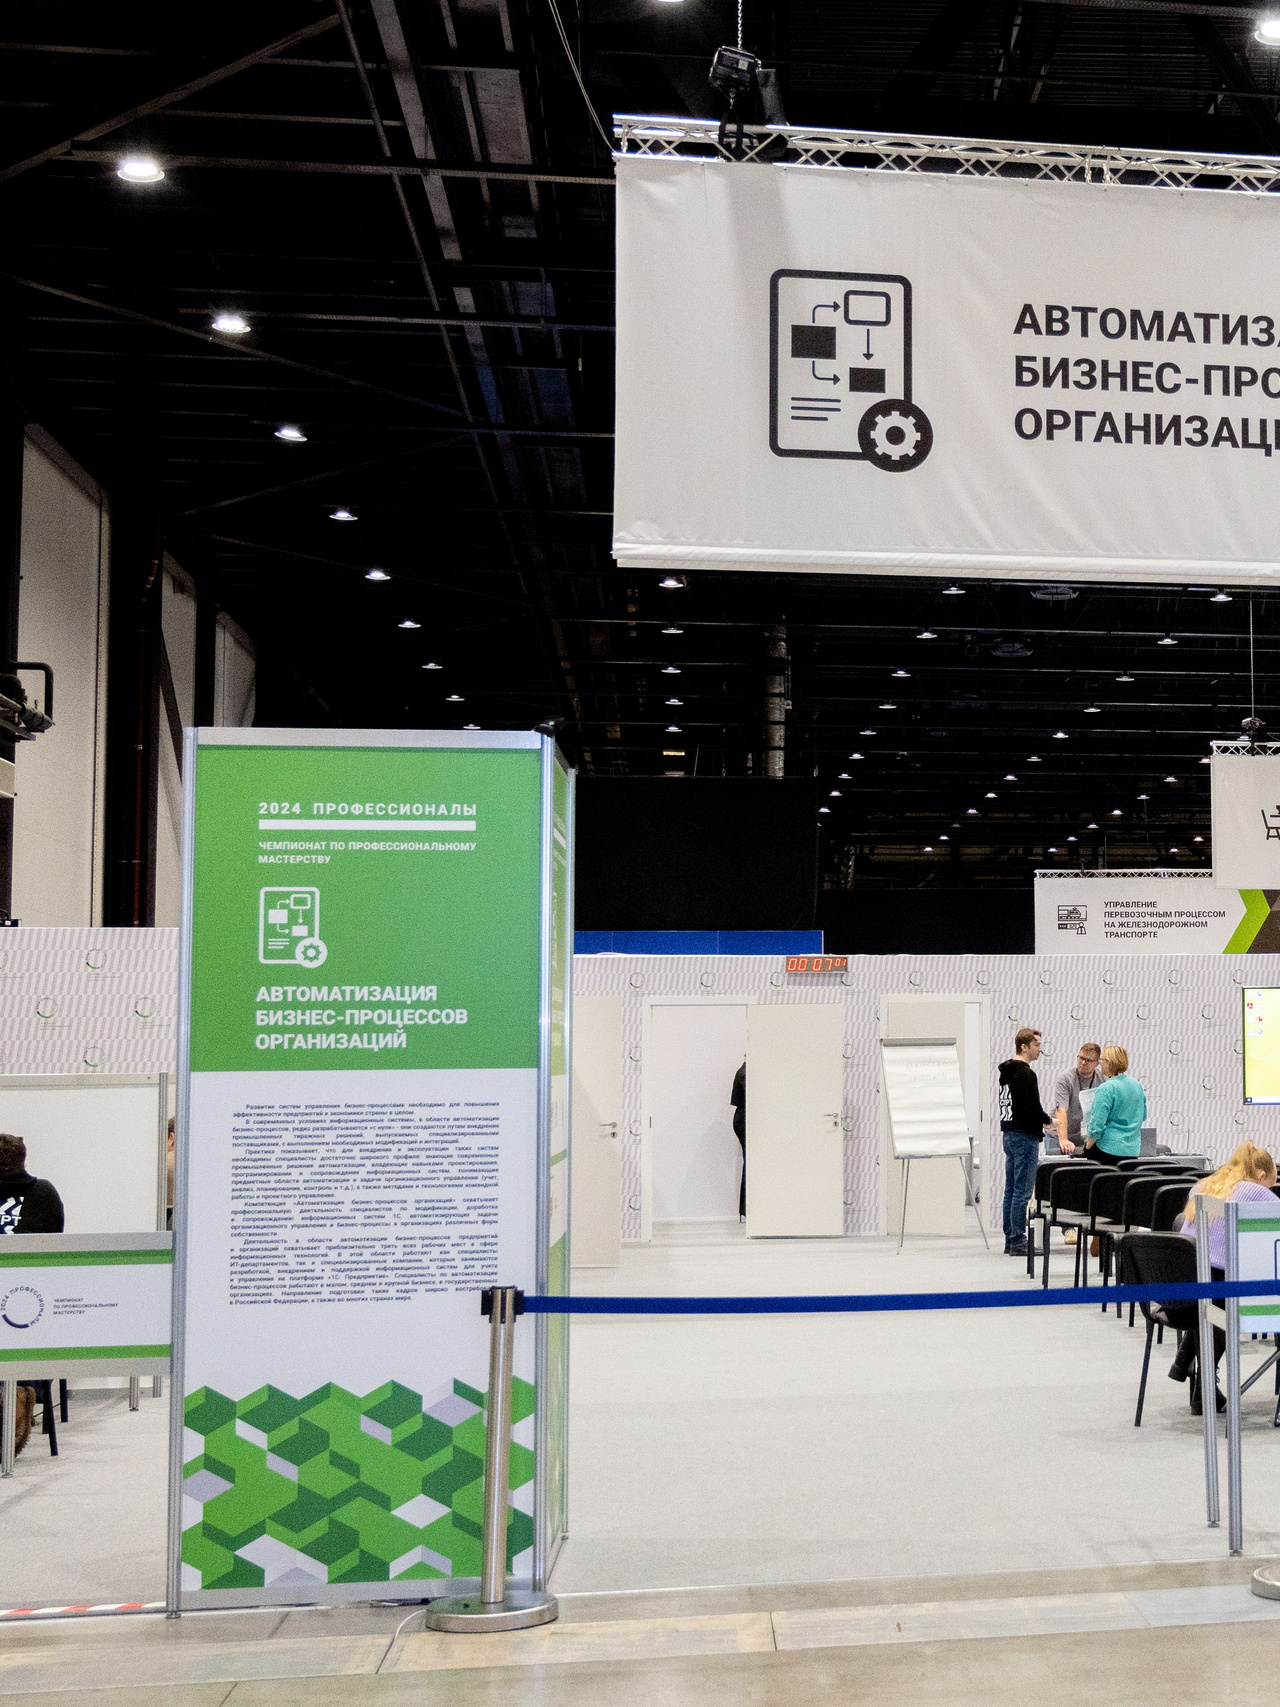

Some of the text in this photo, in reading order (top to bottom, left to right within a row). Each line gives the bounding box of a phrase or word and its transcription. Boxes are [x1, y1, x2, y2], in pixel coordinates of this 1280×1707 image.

[258, 802, 477, 816] 2024 ПРОФЕССИОНАЛЫ
[258, 841, 477, 851] ЧЕМПИОНАТ ПО ПРОФЕССИОНАЛЬНОМУ
[258, 854, 331, 864] МАСТЕРСТВУ
[1104, 901, 1158, 909] УПРАВЛЕНИЕ
[1104, 910, 1226, 919] ПЕРЕВОЗОЧНЫМ ПРОЦЕССОМ
[1104, 920, 1208, 930] НА ЖЕЛЕЗНОДОРОЖНОМ
[1104, 931, 1158, 939] ТРАНСПОРТЕ
[787, 957, 809, 972] 00
[812, 957, 833, 972] 07
[255, 986, 438, 1005] АВТОМАТИЗАЦИЯ
[255, 1009, 468, 1029] БИЗНЕС-ПРОЦЕССОВ
[255, 1029, 407, 1051] ОРГАНИЗАЦИЙ
[0, 1215, 22, 1226] РТ
[9, 1286, 45, 1326] ПРОФЕССИОНАЛЫ
